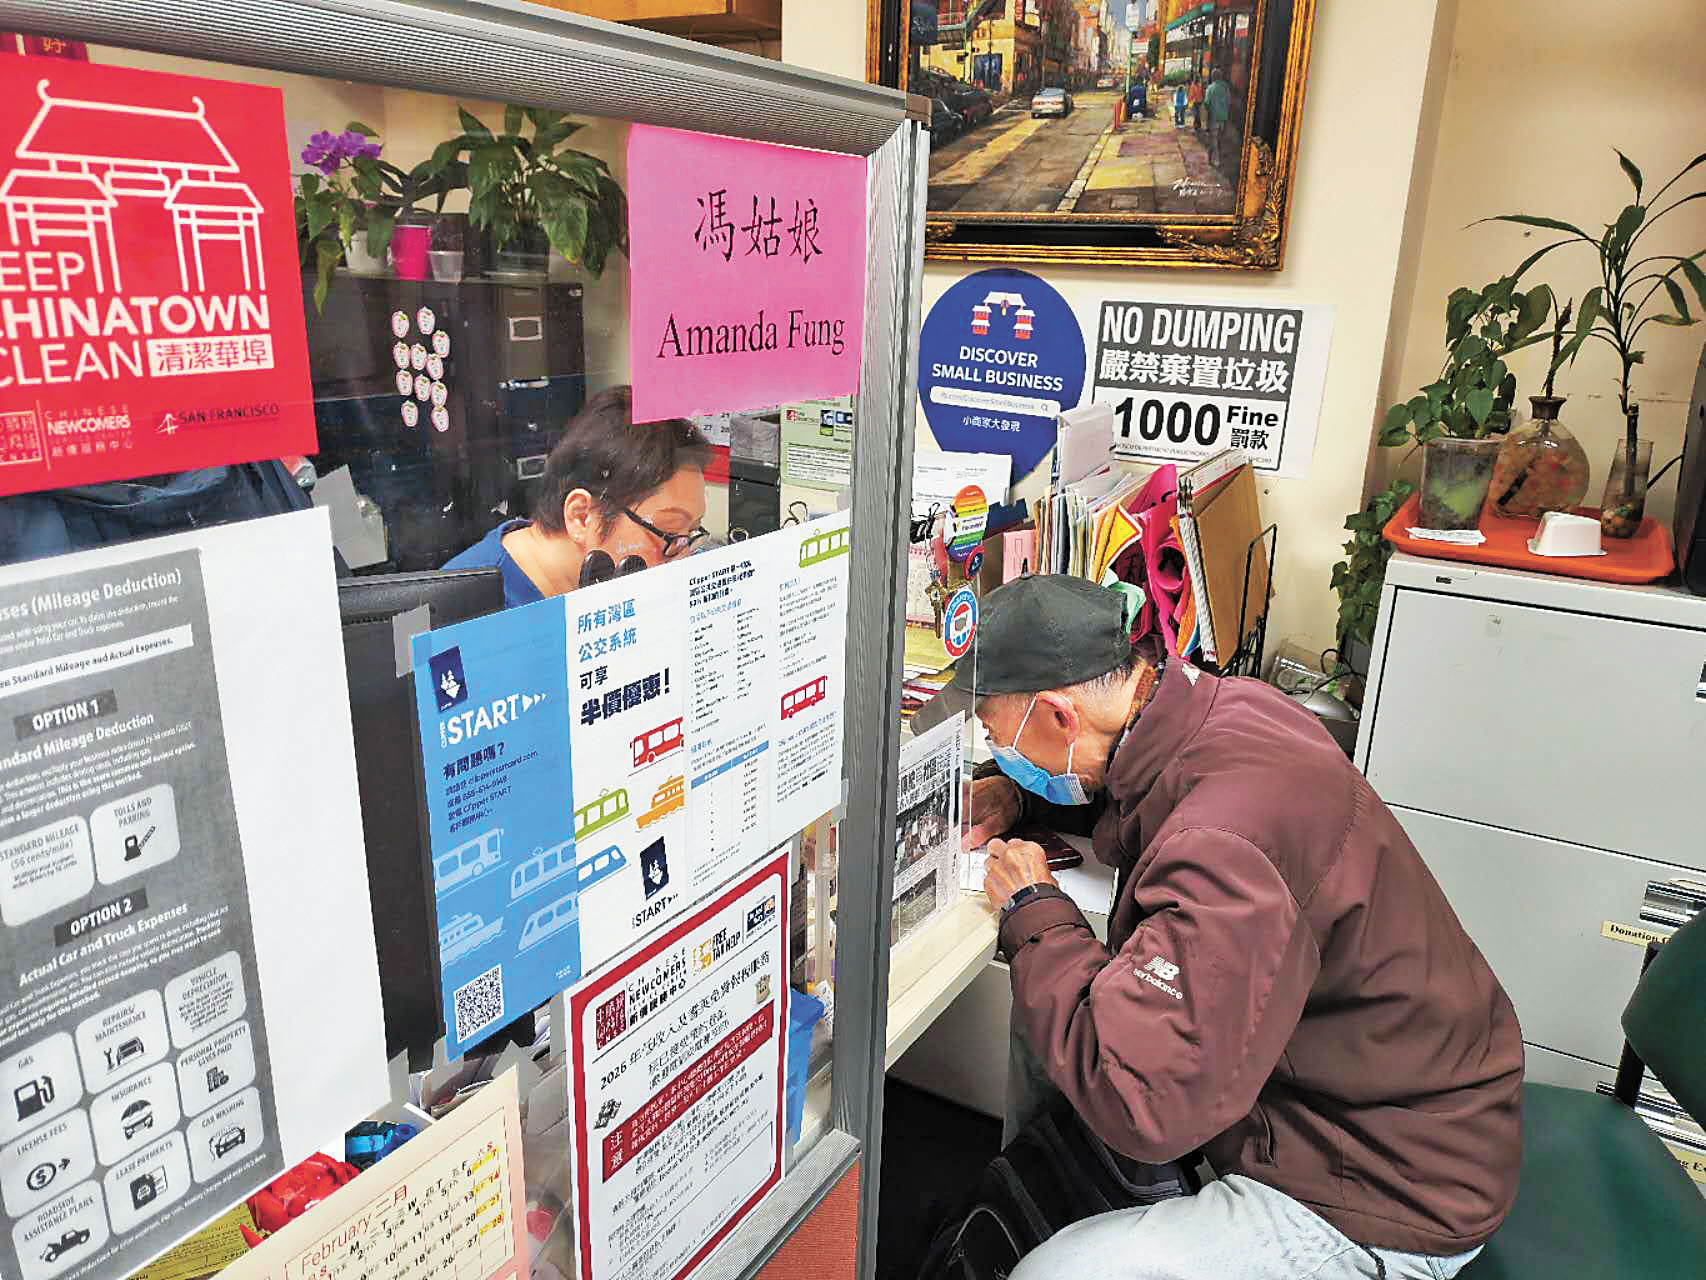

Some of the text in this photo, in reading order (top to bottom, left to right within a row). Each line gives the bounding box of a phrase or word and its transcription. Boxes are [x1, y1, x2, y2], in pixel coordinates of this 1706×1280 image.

[694, 189, 823, 264] 馮姑娘
[0, 251, 85, 291] EEP
[0, 294, 270, 339] HINATOWN
[656, 309, 845, 358] Amanda Fung
[1102, 305, 1296, 354] NO DUMPING
[156, 342, 268, 373] 清潔華埠
[959, 345, 1038, 368] DISCOVER
[1100, 348, 1290, 394] 嚴禁棄置垃圾
[932, 363, 1063, 392] SMALL BUSINESS
[47, 414, 131, 436] NEWCOMERS
[178, 410, 206, 424] SAN
[210, 404, 279, 421] FRANCISCO
[1227, 405, 1278, 427] Fine
[1230, 428, 1269, 450] 罰款
[0, 603, 28, 622] ses
[31, 588, 100, 616] (Mileage
[103, 567, 182, 599] Deduction)
[577, 598, 637, 634] 所有灣區
[578, 627, 637, 663] 公交系統
[12, 665, 53, 687] Standard
[55, 658, 91, 675] Mileage
[109, 645, 135, 662] Actual
[579, 665, 609, 690] 可享
[32, 699, 99, 731] OPTION 1
[43, 733, 94, 757] Mileage
[96, 713, 154, 739] Deduction
[447, 693, 520, 745] START
[70, 897, 133, 937] OPTION 2
[635, 896, 666, 928] START
[19, 902, 188, 987] Actual Car and Truck Expenses
[629, 957, 686, 1006] NEWCOMERS
[18, 1055, 34, 1070] GAS
[600, 1060, 628, 1090] 2026
[301, 1213, 373, 1275] February
[376, 1184, 408, 1217] 二月
[384, 1252, 397, 1266] 10
[412, 1230, 423, 1244] 11
[438, 1209, 450, 1222] 12
[463, 1190, 475, 1202] 13
[385, 1227, 393, 1239] 3
[441, 1186, 448, 1198] 5
[350, 1241, 360, 1256] M
[414, 1253, 426, 1267] 18
[440, 1233, 452, 1246] 19
[464, 1213, 476, 1226] 20
